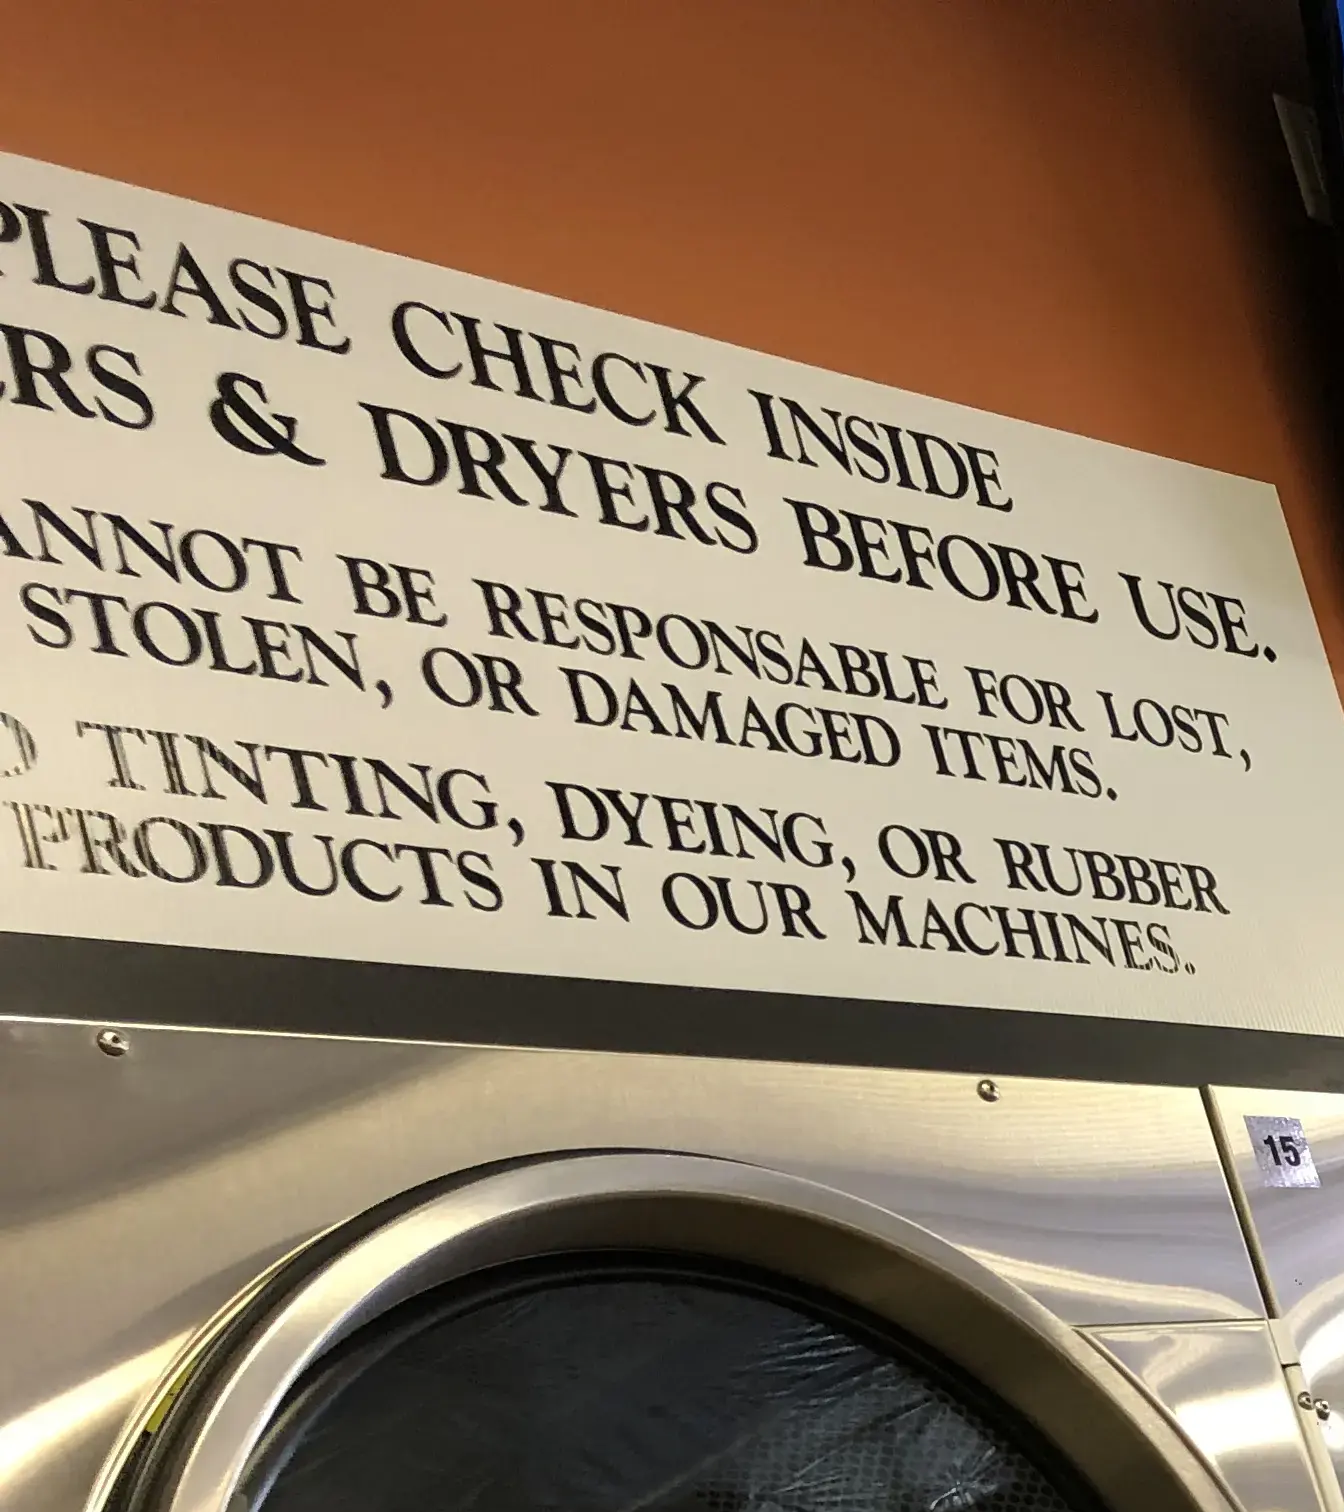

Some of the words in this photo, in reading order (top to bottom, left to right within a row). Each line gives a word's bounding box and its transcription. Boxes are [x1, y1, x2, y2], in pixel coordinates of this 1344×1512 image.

[0, 324, 153, 430] RS
[210, 372, 326, 466] &
[358, 401, 759, 554] DRYERS
[783, 497, 1099, 623] BEFORE
[1118, 572, 1276, 662] USE.
[391, 302, 725, 444] CHECK
[748, 388, 1012, 512] INSIDE
[19, 582, 394, 709] STOLEN,
[421, 647, 539, 716] OR
[558, 667, 901, 768] DAMAGED
[922, 724, 1118, 800] ITEMS.
[337, 555, 449, 627] BE
[472, 578, 948, 710] RESPONSABLE
[965, 666, 1083, 732] FOR
[1097, 690, 1253, 773] LOST,
[12, 802, 503, 912] PRODUCTS
[530, 857, 630, 922] IN
[660, 872, 827, 941] OUR
[845, 889, 1196, 976] MACHINES.
[76, 721, 525, 848] TINTING,
[545, 781, 856, 881] DYEING,
[877, 824, 976, 884] OR
[994, 838, 1230, 914] RUBBER
[1263, 1135, 1301, 1166] 15
